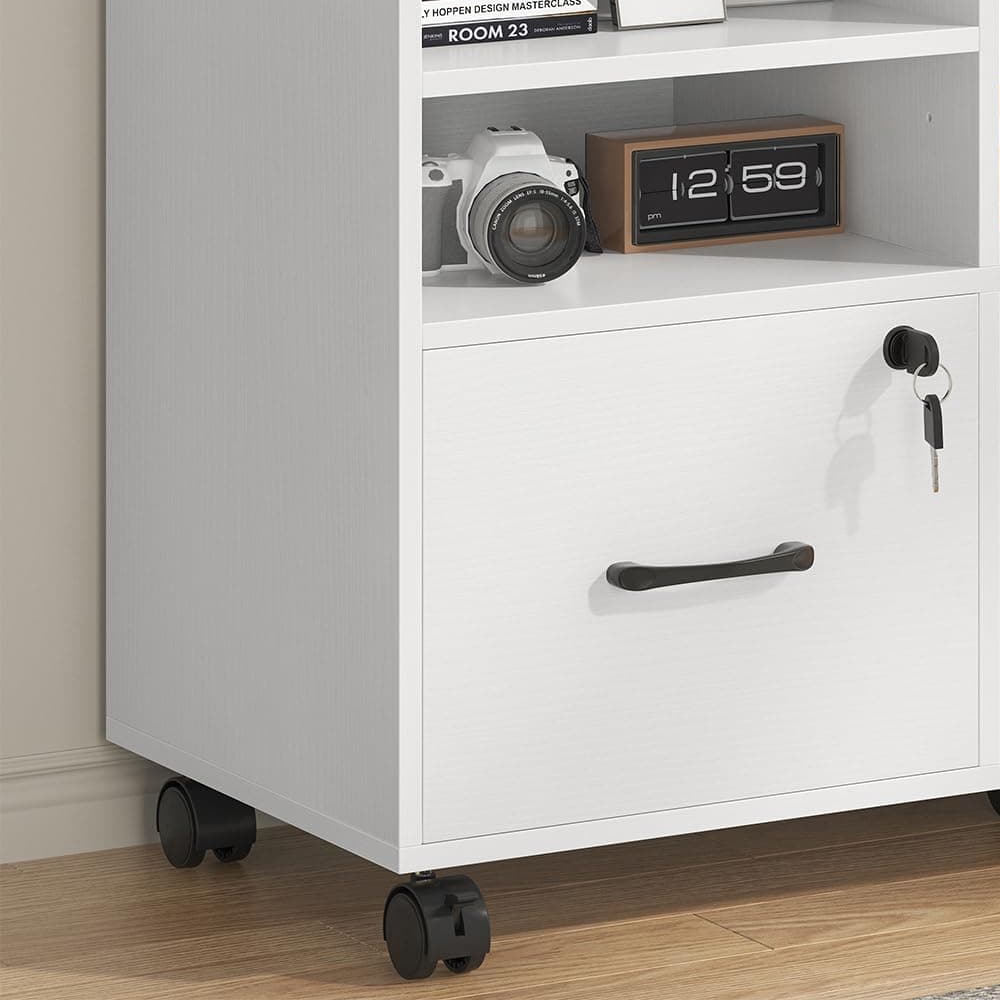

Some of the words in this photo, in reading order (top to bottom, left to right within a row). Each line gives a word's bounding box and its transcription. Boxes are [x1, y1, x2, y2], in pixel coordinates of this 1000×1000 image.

[433, 6, 471, 17] HOPPEN
[474, 3, 509, 13] DESIGN
[449, 26, 503, 42] ROOM
[508, 23, 528, 37] 23
[672, 168, 718, 200] 12
[742, 161, 807, 193] 59
[648, 213, 662, 221] pm
